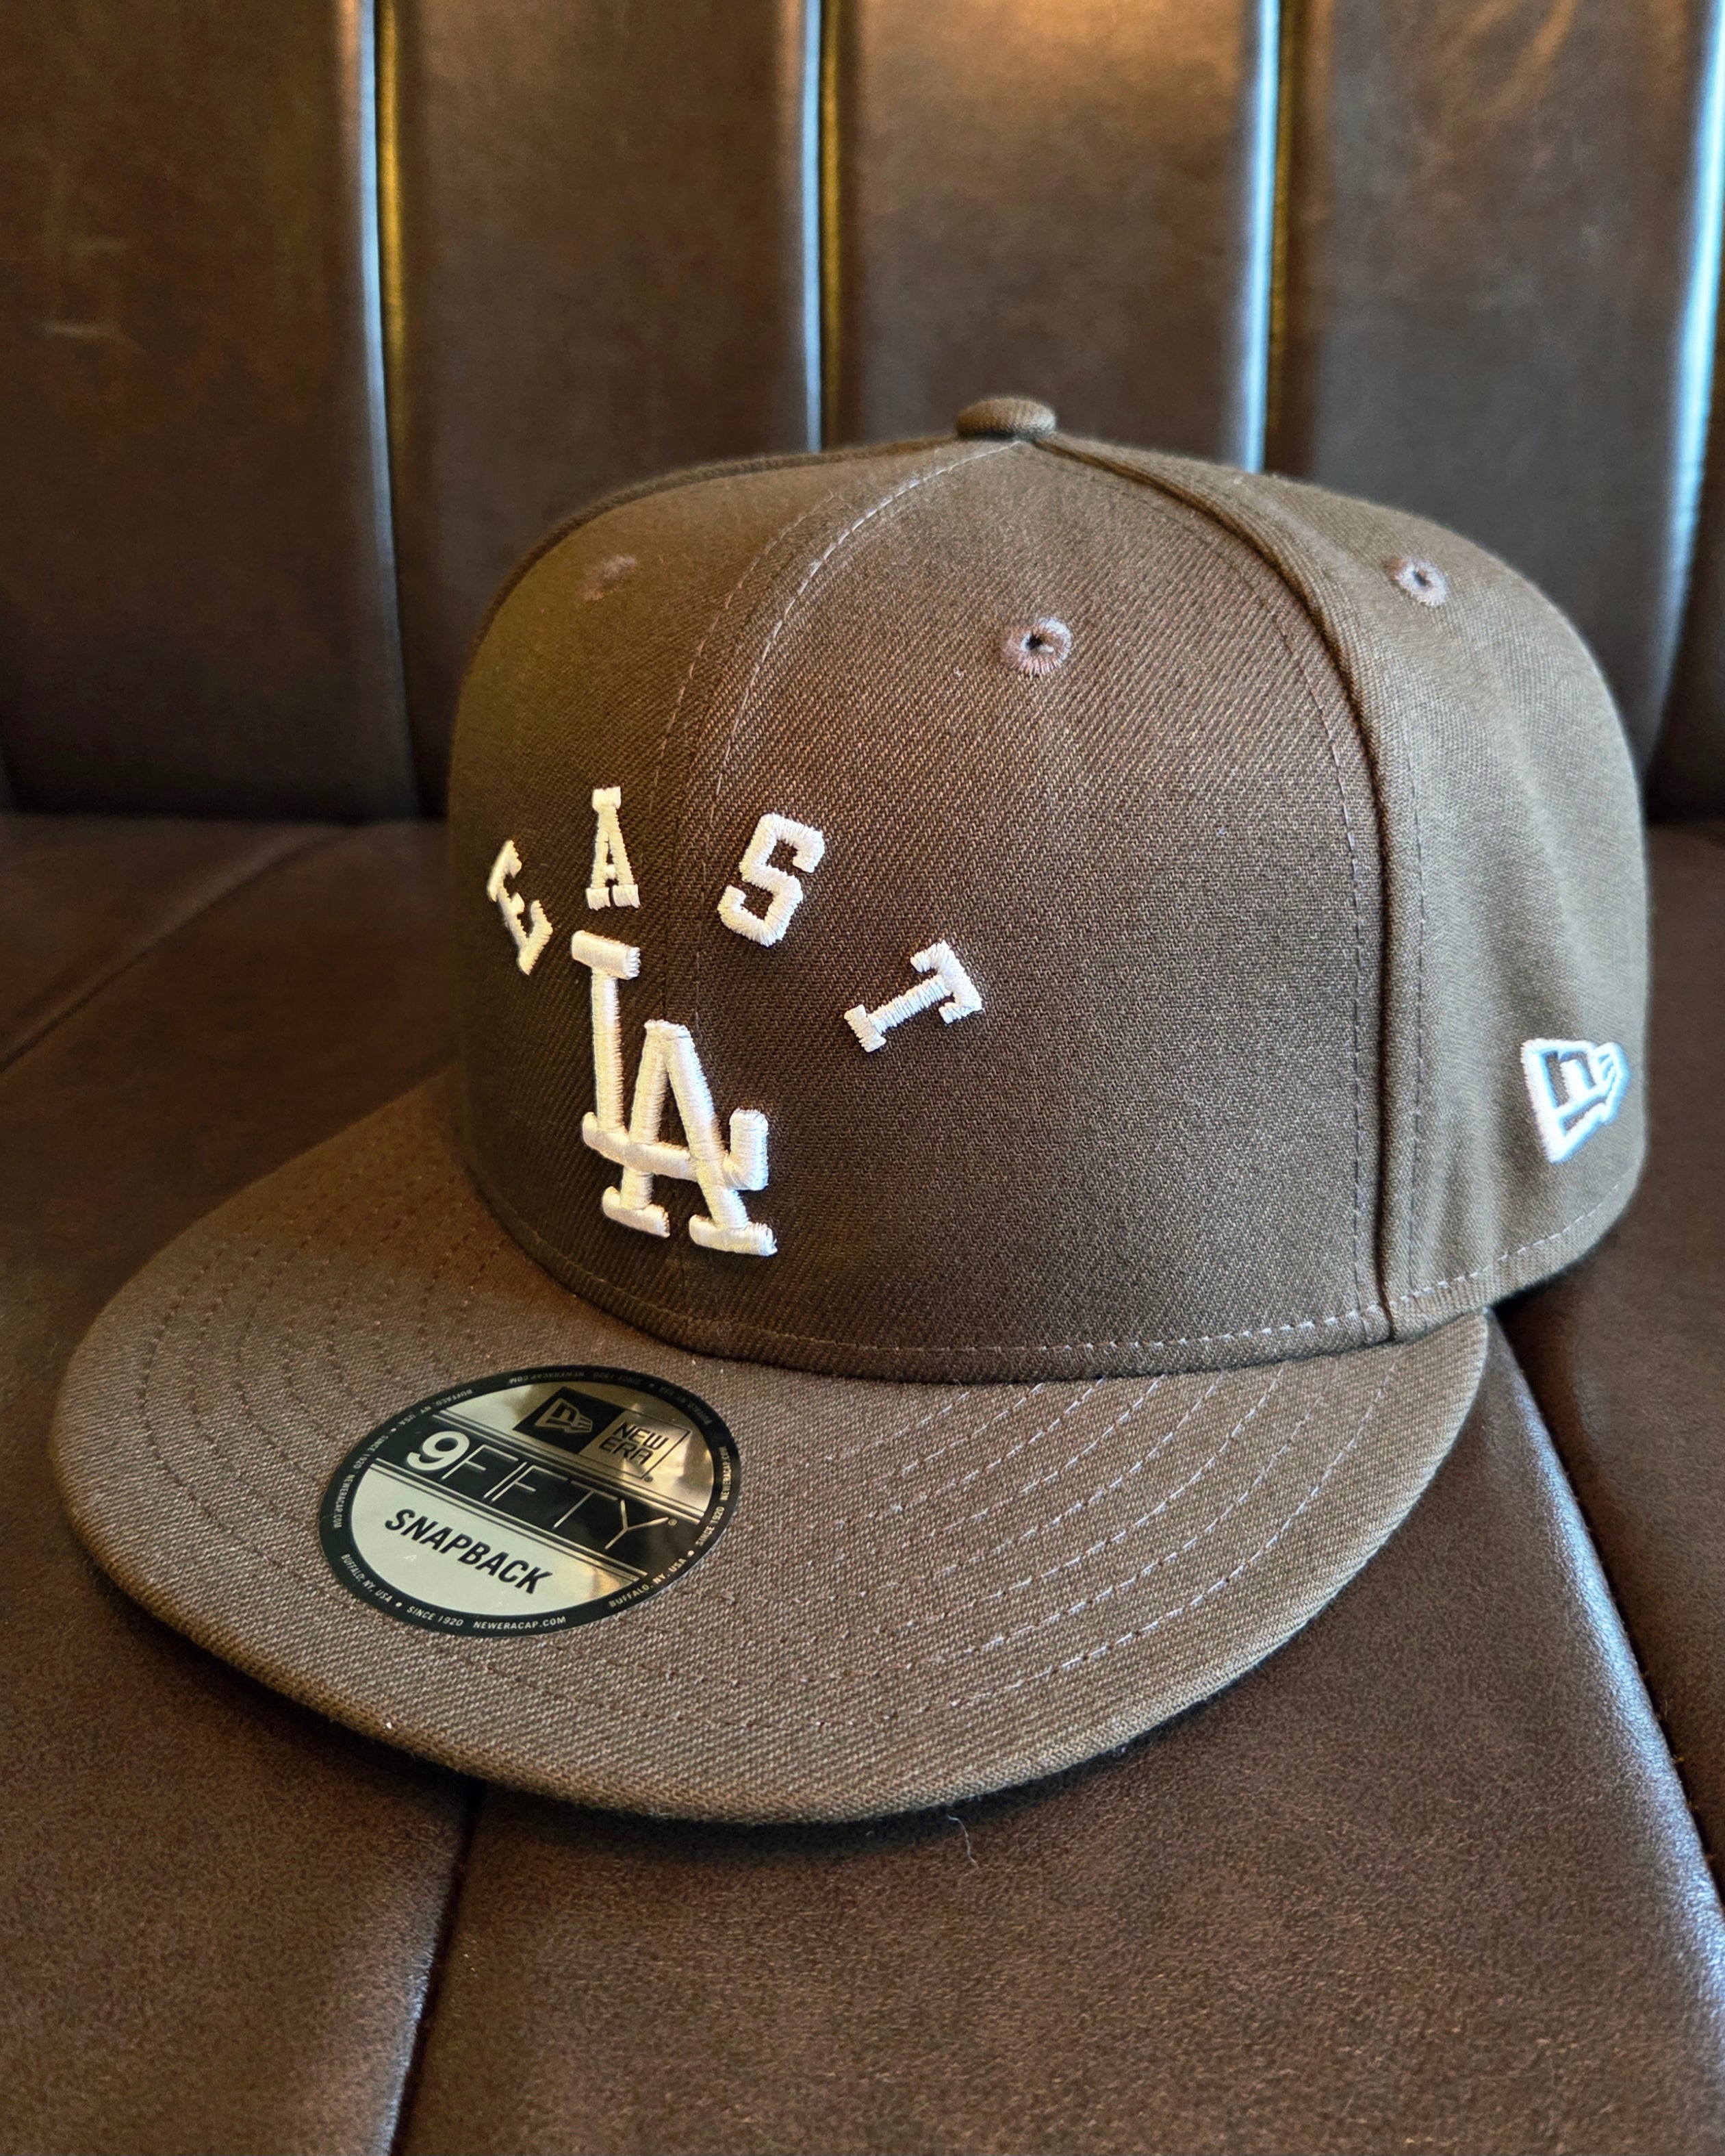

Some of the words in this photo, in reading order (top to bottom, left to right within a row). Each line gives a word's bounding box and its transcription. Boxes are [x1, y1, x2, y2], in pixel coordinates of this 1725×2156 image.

[487, 786, 984, 1052] EAST
[571, 930, 778, 1256] LA
[613, 1421, 669, 1450] NEW
[385, 1508, 552, 1595] SNAPBACK
[668, 1558, 687, 1573] USA
[695, 1525, 715, 1546] SINCE
[712, 1506, 725, 1524] 1920
[374, 1588, 393, 1603] USA
[407, 1606, 435, 1621] SINCE
[438, 1615, 463, 1627] 1920
[473, 1616, 566, 1629] NEWERACAP.COM
